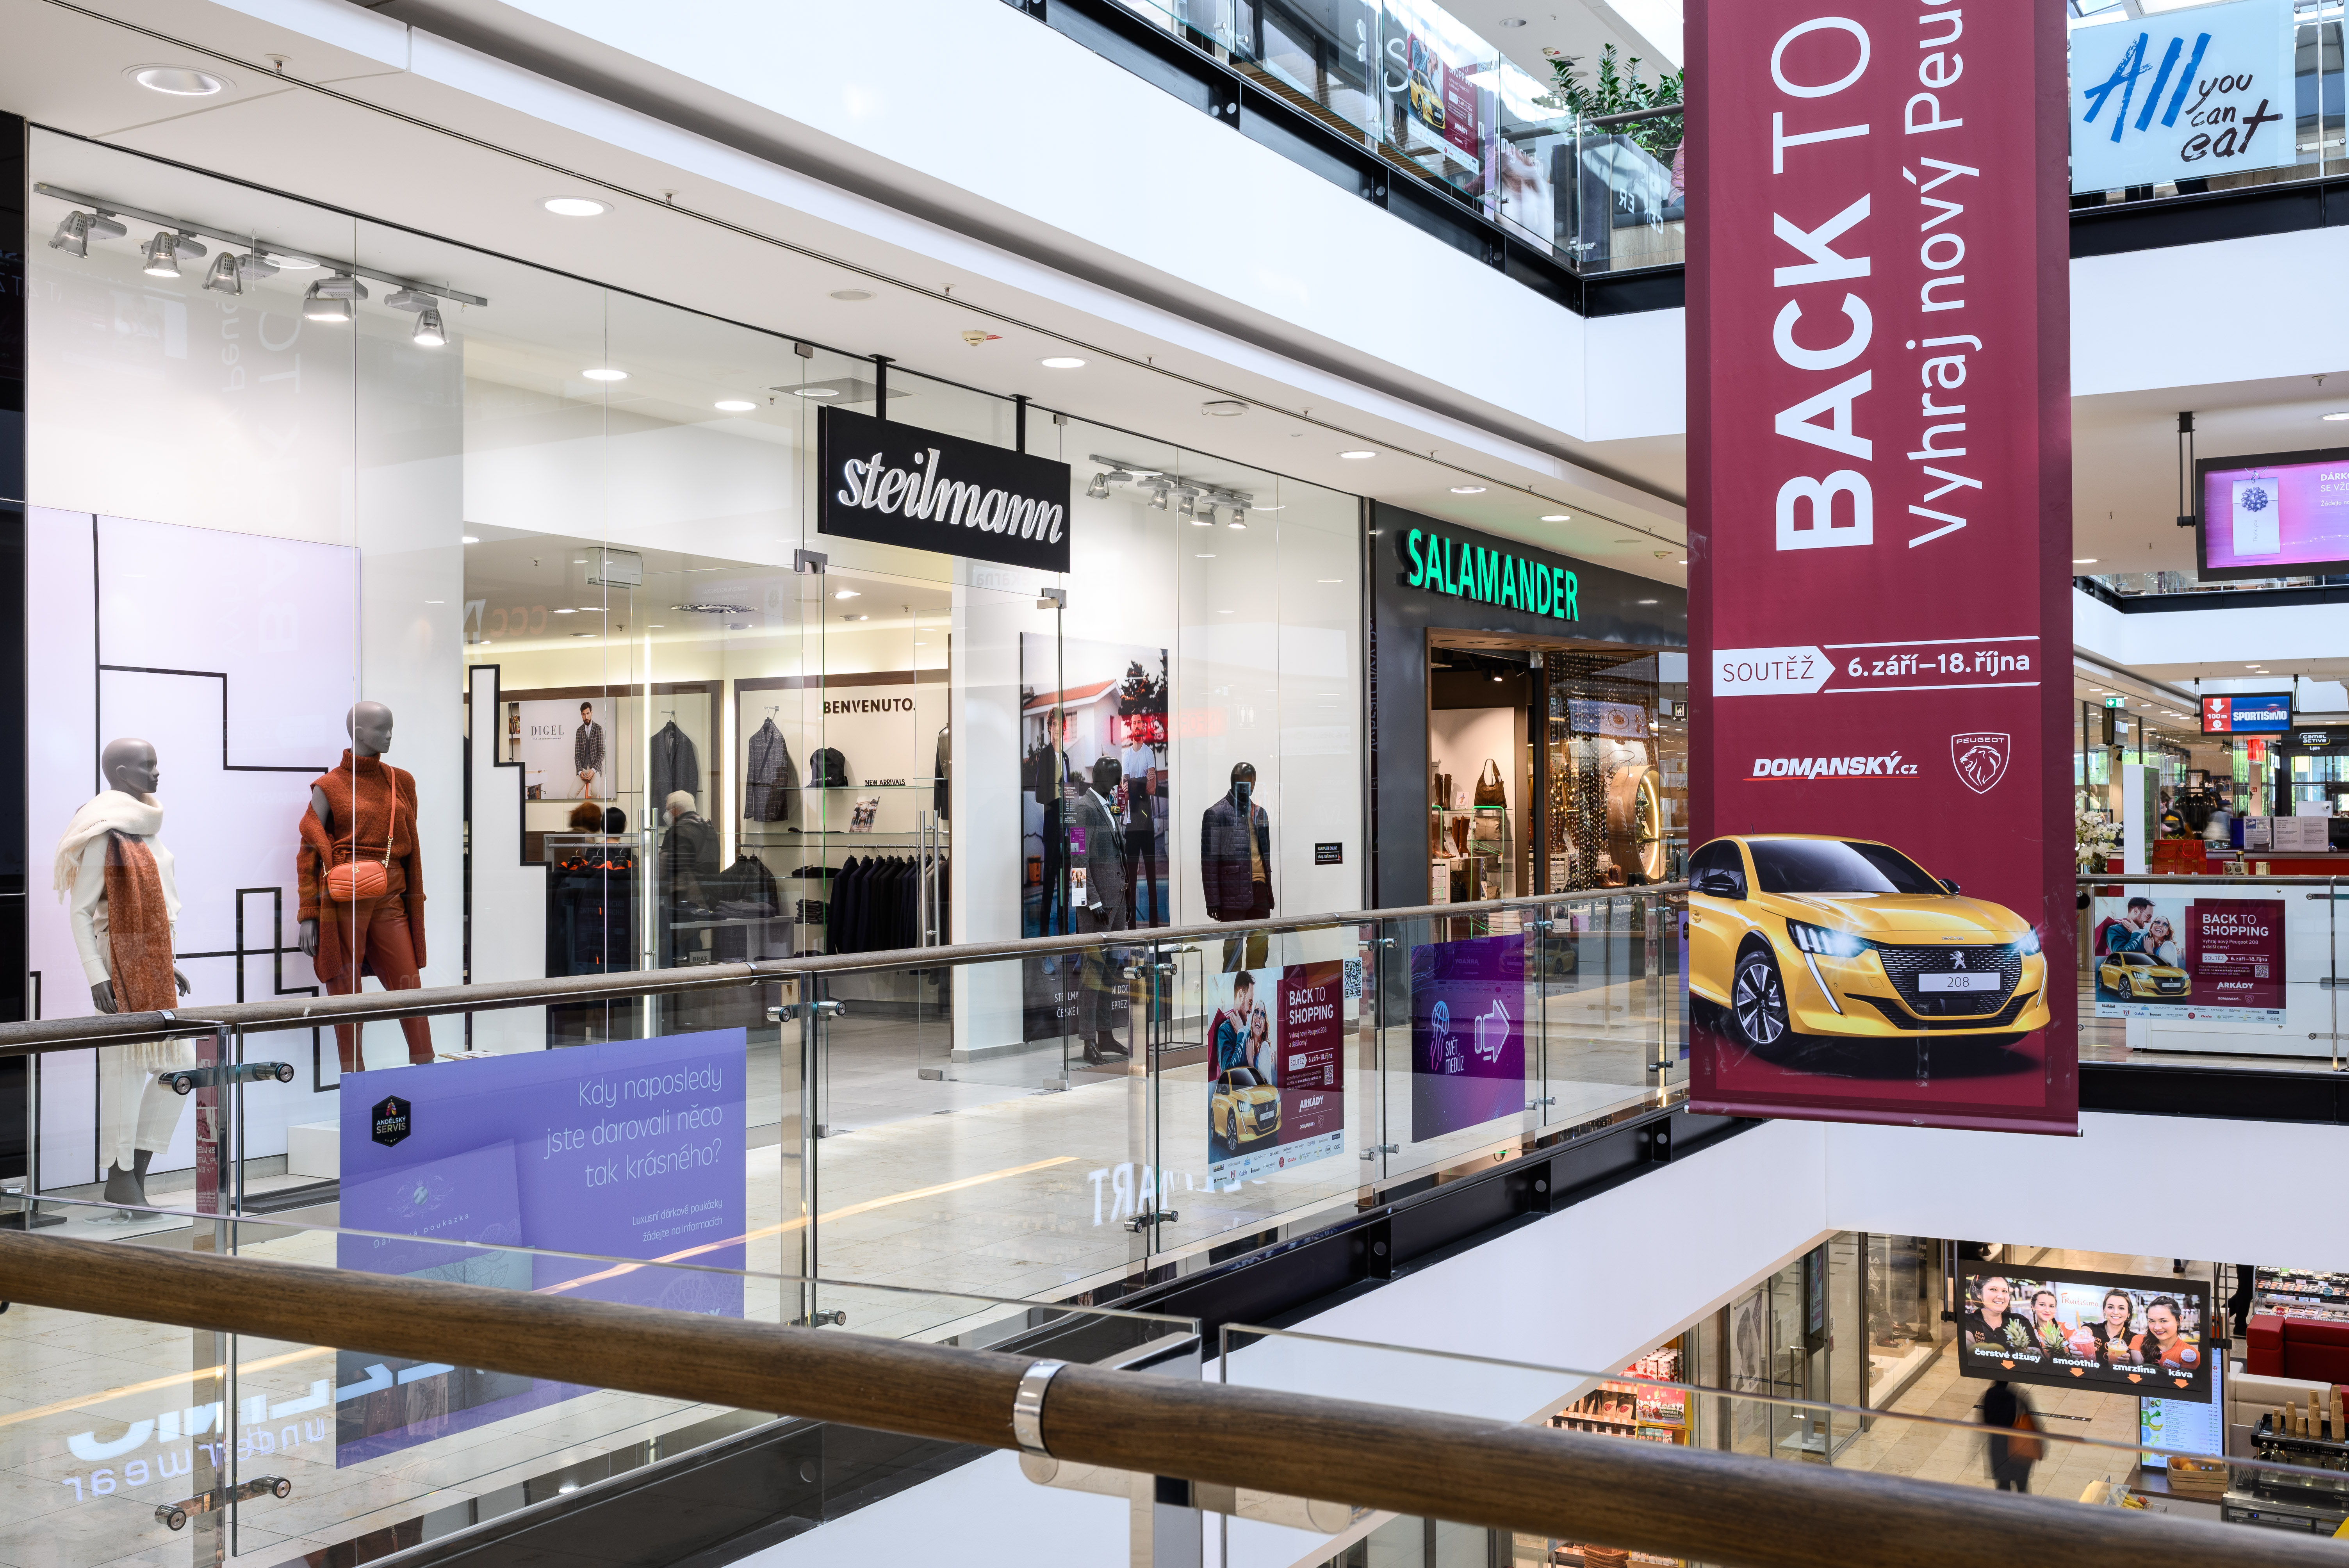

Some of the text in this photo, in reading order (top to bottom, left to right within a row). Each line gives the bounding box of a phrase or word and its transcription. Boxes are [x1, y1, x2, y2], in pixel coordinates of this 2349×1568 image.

[2083, 32, 2212, 143] All
[2185, 74, 2253, 115] you
[2192, 106, 2236, 127] can
[2180, 99, 2283, 162] eat
[1903, 157, 1979, 312] nový
[1771, 17, 1873, 551] BACK TO
[1906, 335, 1982, 549] Vyhraj
[838, 448, 1064, 544] steilmann
[1408, 528, 1579, 621] SALAMANDER
[1722, 655, 1815, 682] SOUTĚŽ
[824, 698, 916, 714] BENVENUTO.
[531, 725, 564, 736] DIGEL
[1753, 751, 1918, 780] DOMANSKÝ.cz
[2203, 914, 2256, 924] BACK TO
[2203, 926, 2269, 936] SHOPPING
[1947, 976, 1970, 987] 208
[2217, 981, 2254, 990] ARKÁDY
[1289, 986, 1326, 1006] BACK TO
[1289, 1004, 1333, 1025] SHOPPING
[1289, 1031, 1299, 1040] Vyhraj
[1307, 1028, 1320, 1036] Peugeot
[1445, 1036, 1458, 1057] SVĚT
[1290, 1056, 1305, 1067] SOUTĚŽ
[1445, 1052, 1464, 1075] MEDÚZ
[579, 1063, 722, 1108] Kdy naposledy
[1299, 1095, 1324, 1113] ARKÁDY
[376, 1115, 406, 1126] ANDĚLSKÝ
[376, 1122, 406, 1134] SERVIS
[544, 1103, 722, 1160] jste darovali něco
[585, 1138, 722, 1188] tak krásného?
[633, 1198, 722, 1226] Luxusní dárkové poukázky
[424, 1213, 469, 1235] poukázka
[643, 1215, 723, 1242] žádejte na Informacích
[1974, 1348, 2041, 1363] čerstvé džusy
[2053, 1357, 2100, 1368] smoothie
[2112, 1363, 2156, 1374] zmrzlina
[2168, 1368, 2193, 1378] káva
